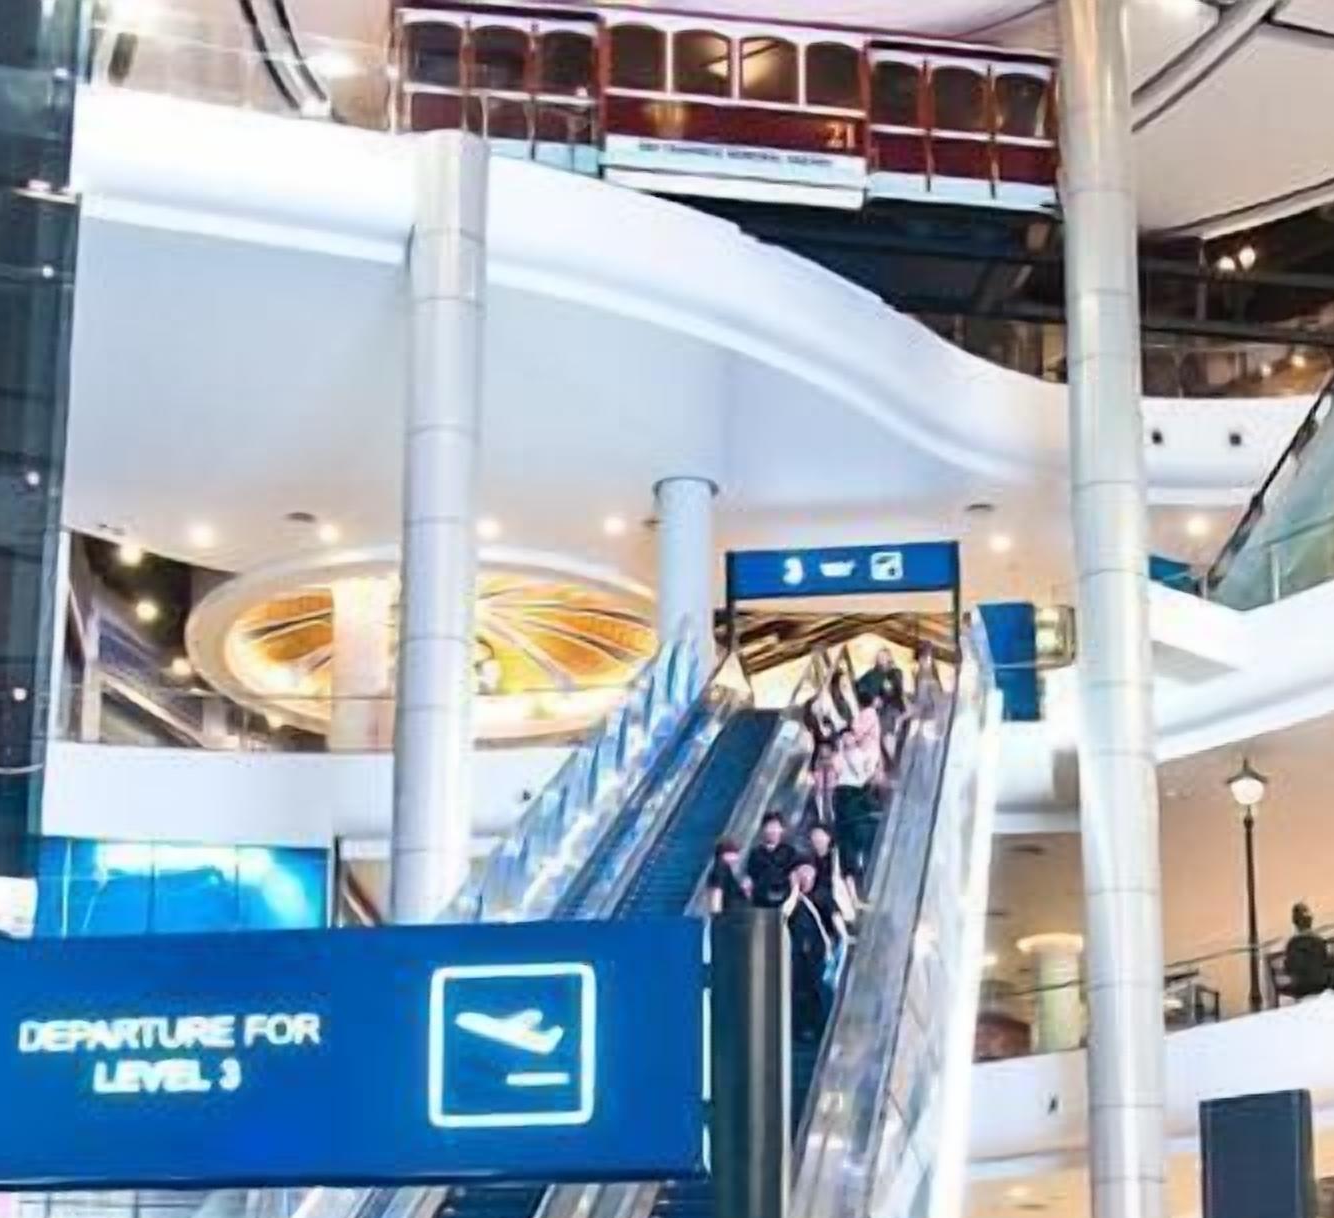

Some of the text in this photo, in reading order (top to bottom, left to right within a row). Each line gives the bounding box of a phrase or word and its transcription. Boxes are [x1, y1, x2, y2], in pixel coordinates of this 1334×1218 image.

[17, 1012, 321, 1052] DEPARTURE FOR
[93, 1057, 242, 1093] LEVEL 3
